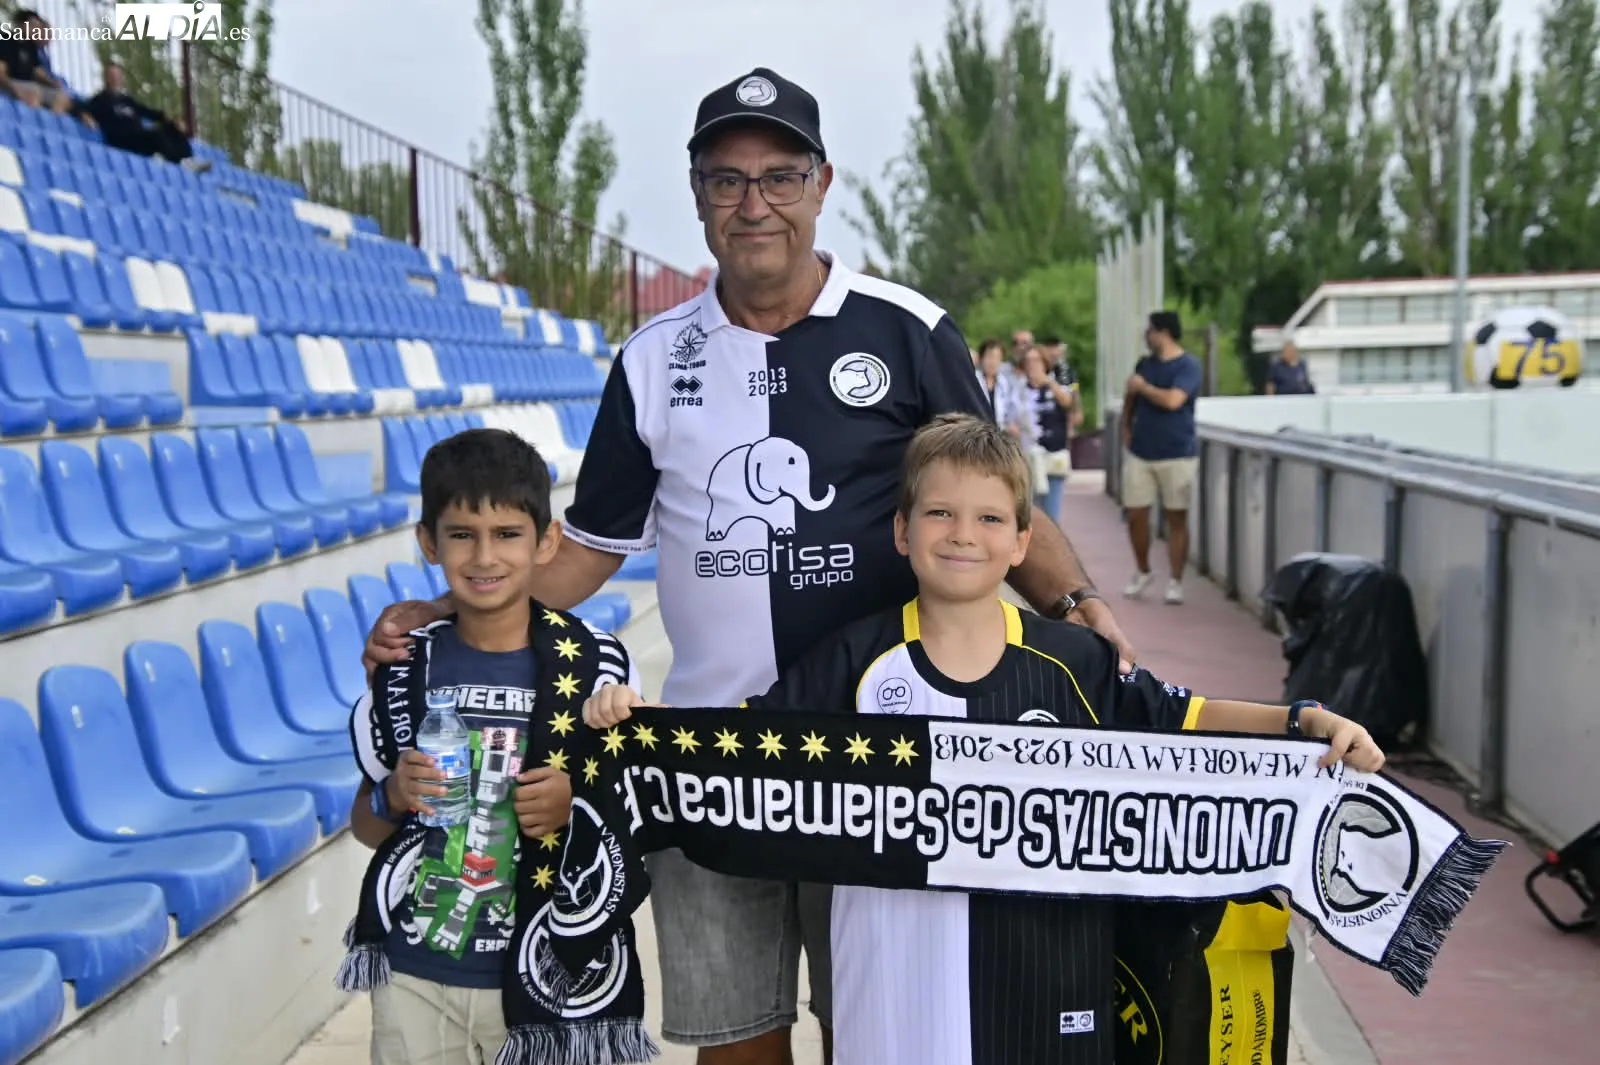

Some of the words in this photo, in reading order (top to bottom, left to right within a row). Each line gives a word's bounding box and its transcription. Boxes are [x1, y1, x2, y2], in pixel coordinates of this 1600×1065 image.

[748, 367, 787, 383] 2013
[1511, 339, 1566, 380] 75
[748, 381, 788, 397] 2023
[790, 569, 853, 590] grupo
[1082, 741, 1136, 769] VDS
[676, 771, 948, 860] Salamanca
[954, 785, 1013, 856] de
[1019, 790, 1297, 873] UNIONISTAS
